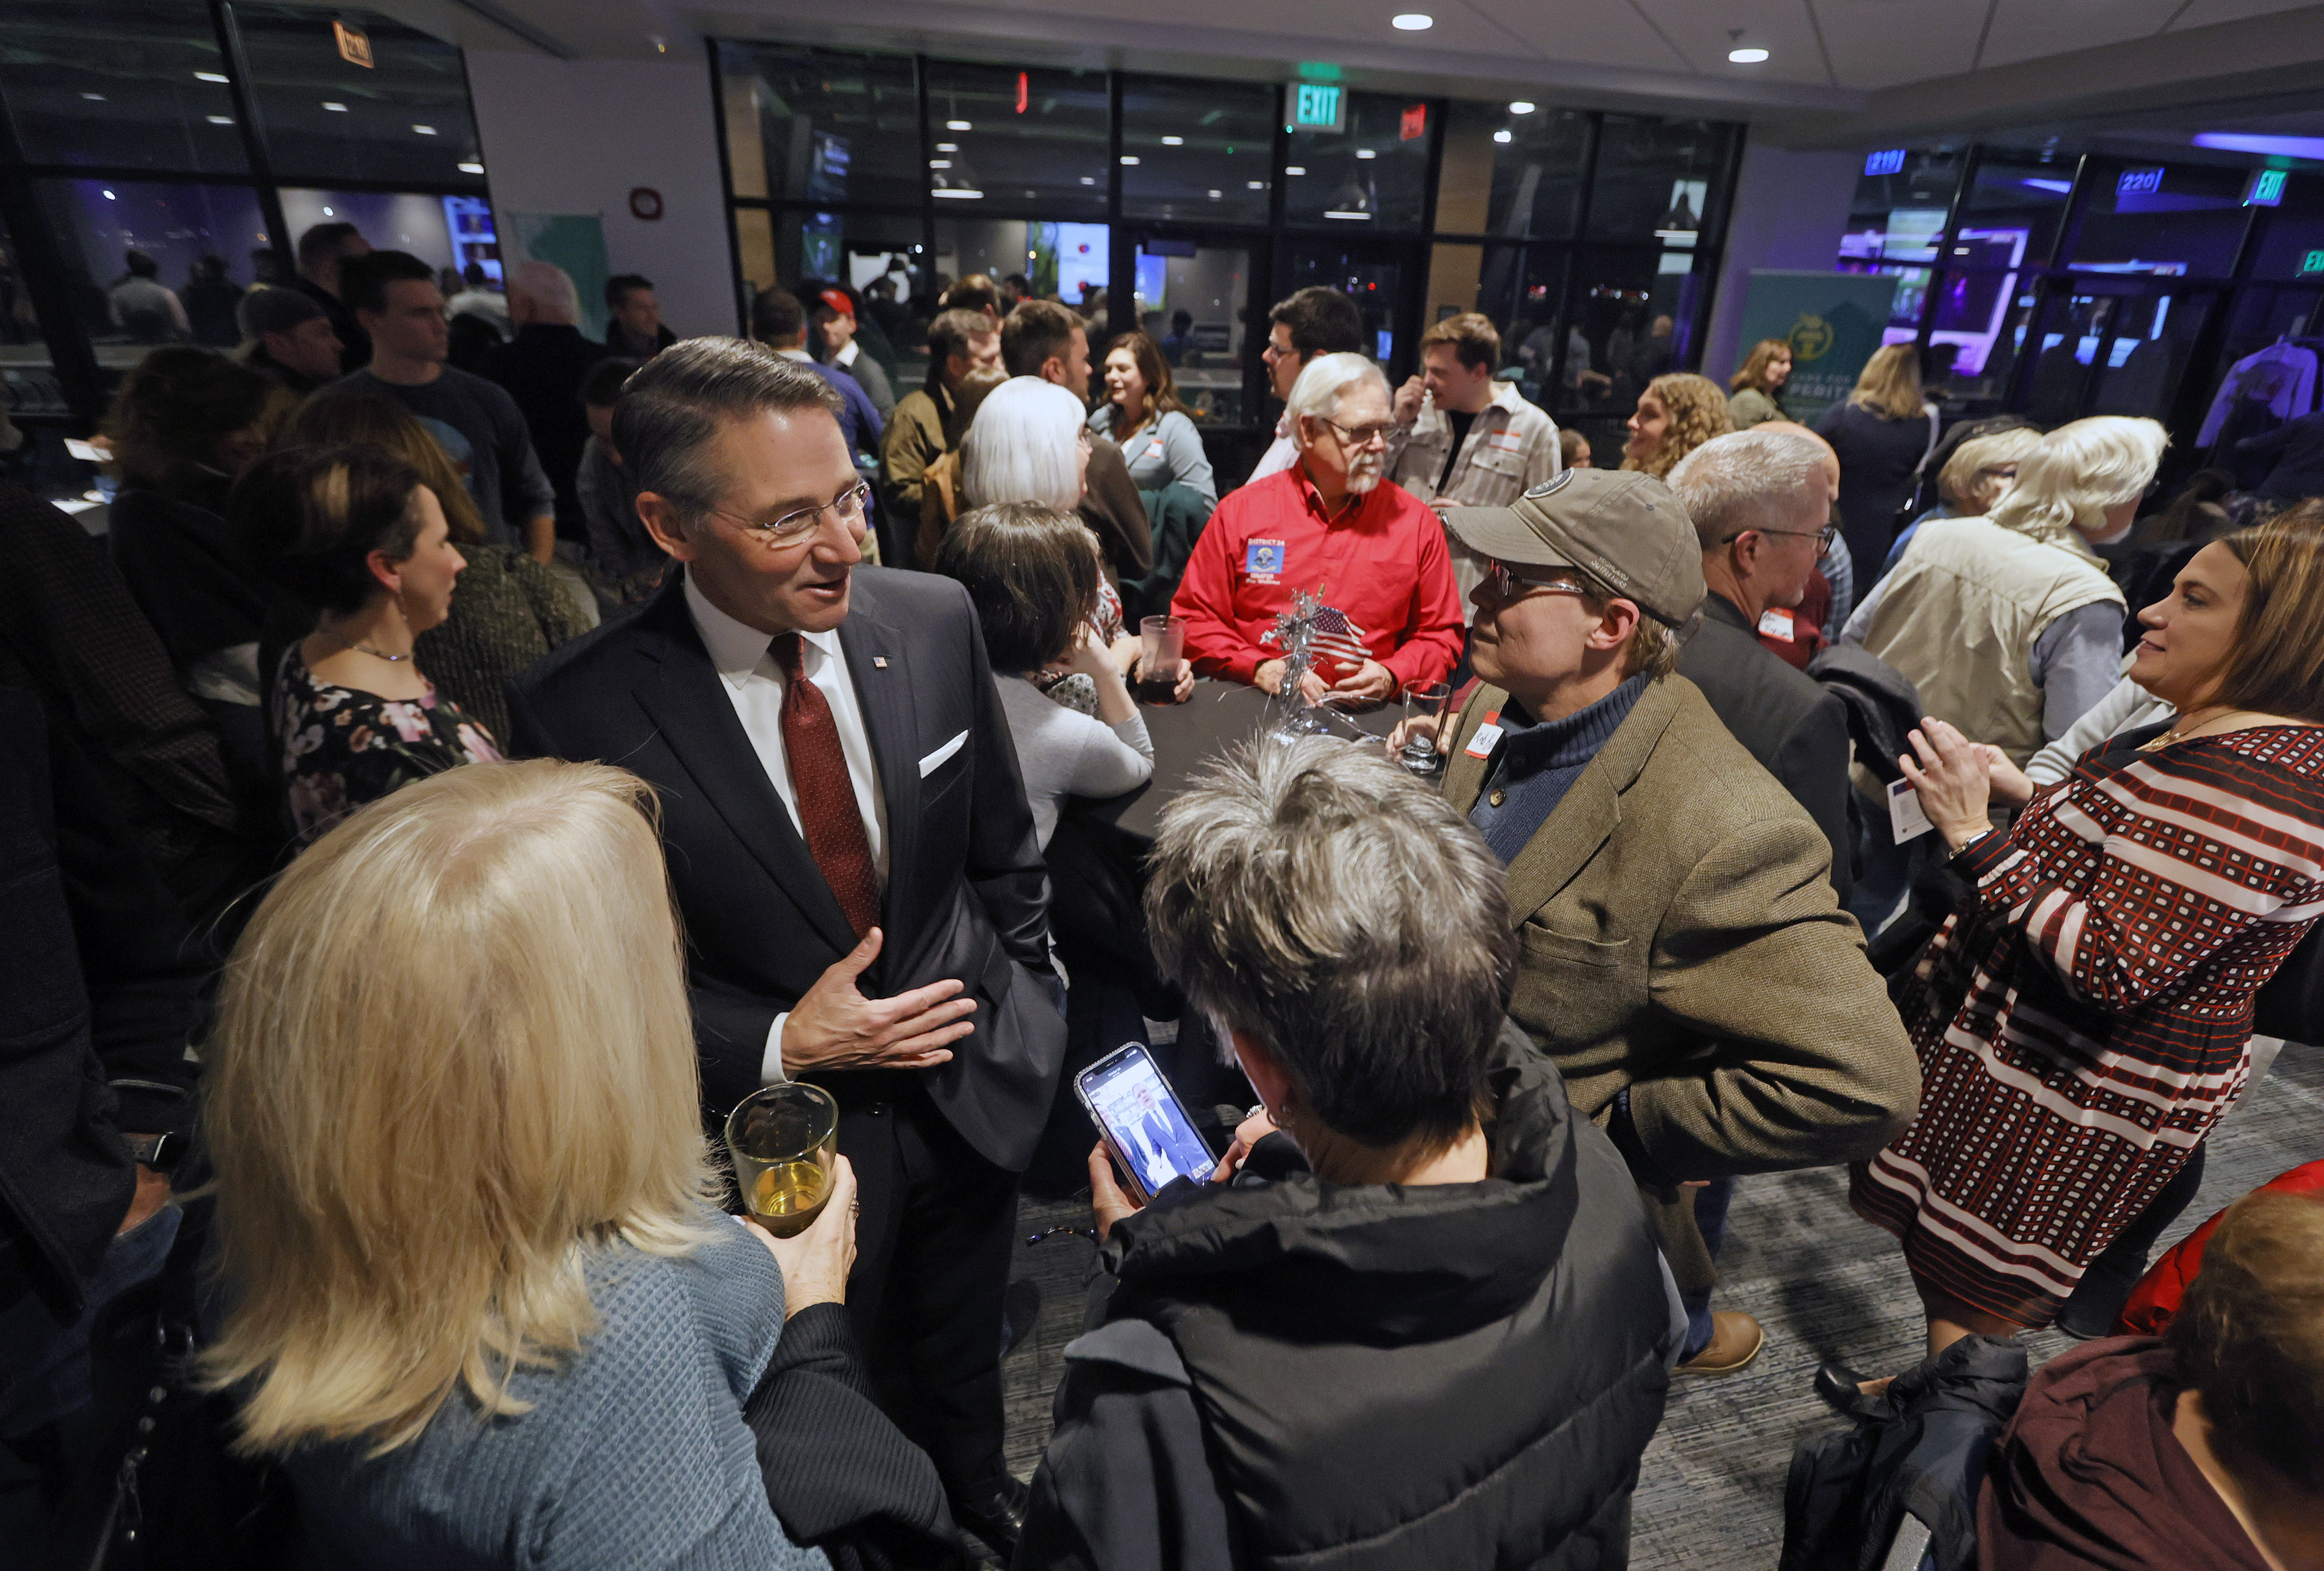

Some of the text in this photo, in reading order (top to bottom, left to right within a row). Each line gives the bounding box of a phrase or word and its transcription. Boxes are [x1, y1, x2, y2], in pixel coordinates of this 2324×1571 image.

[1297, 84, 1340, 126] EXIT
[2122, 172, 2156, 190] 220
[2254, 169, 2288, 201] EXIT
